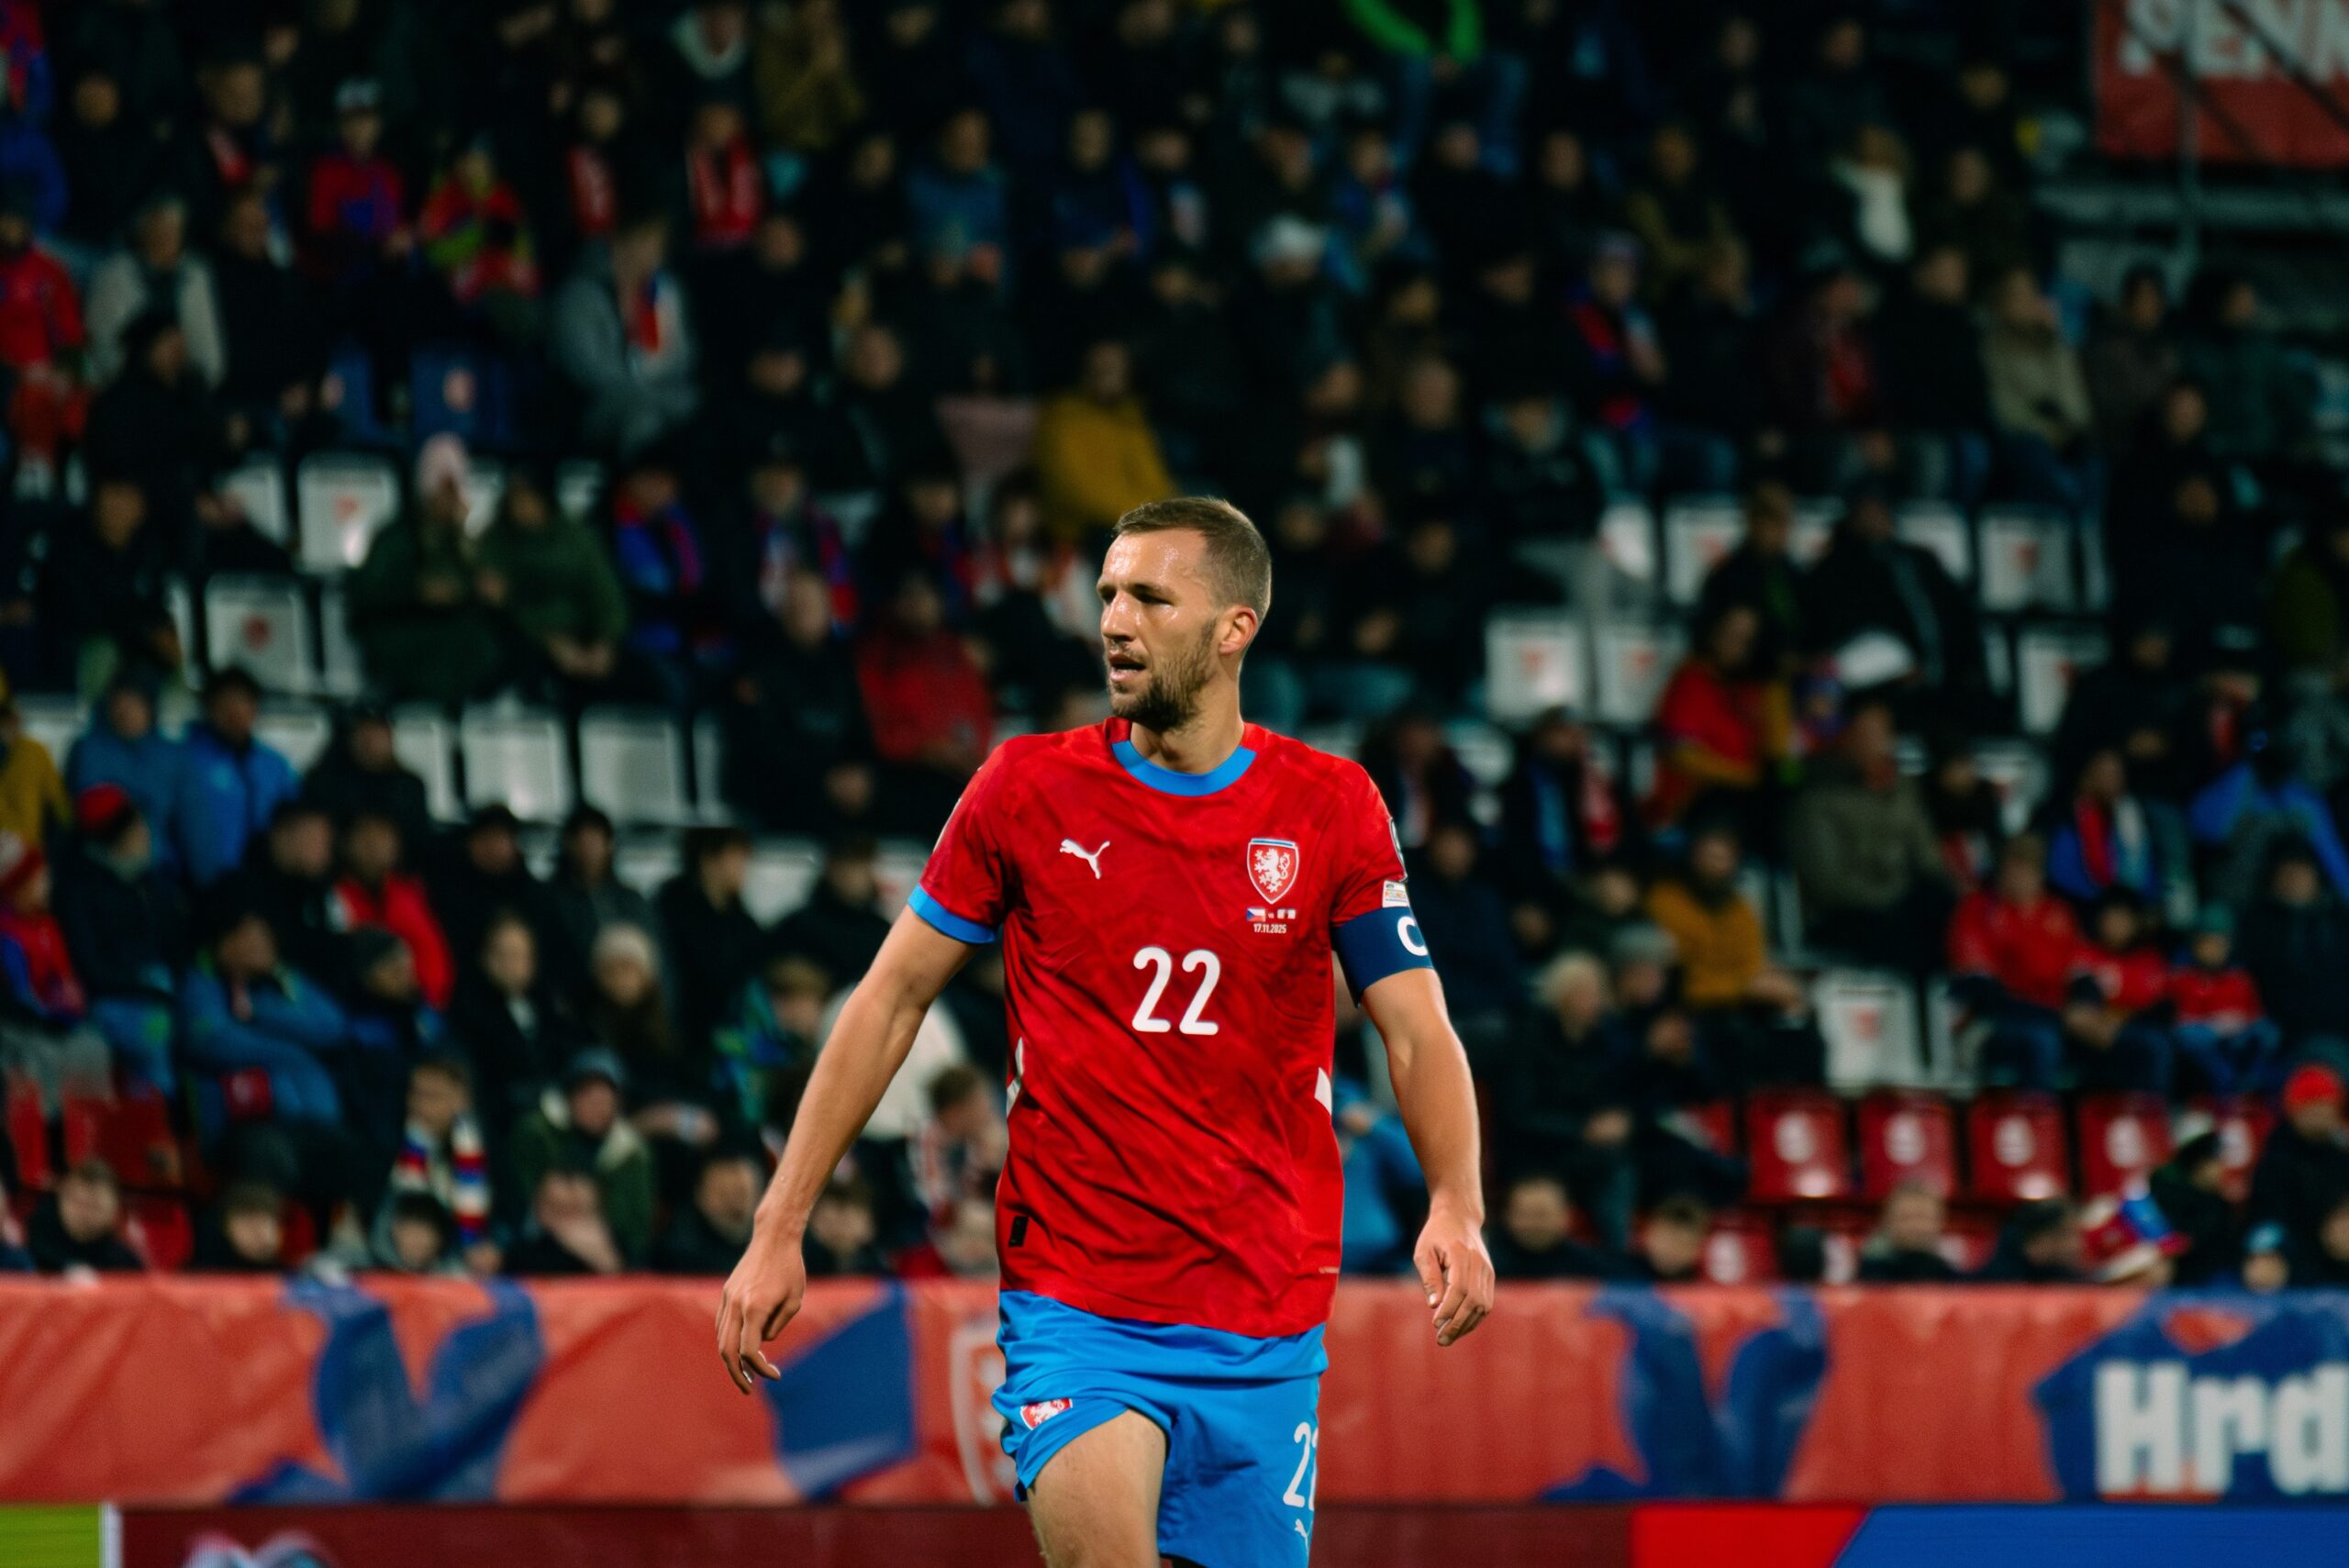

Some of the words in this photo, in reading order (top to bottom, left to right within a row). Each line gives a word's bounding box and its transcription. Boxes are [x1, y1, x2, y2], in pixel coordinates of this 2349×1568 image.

[1252, 923, 1287, 934] 17.11.2025
[1397, 916, 1429, 956] C
[1131, 946, 1221, 1036] 22
